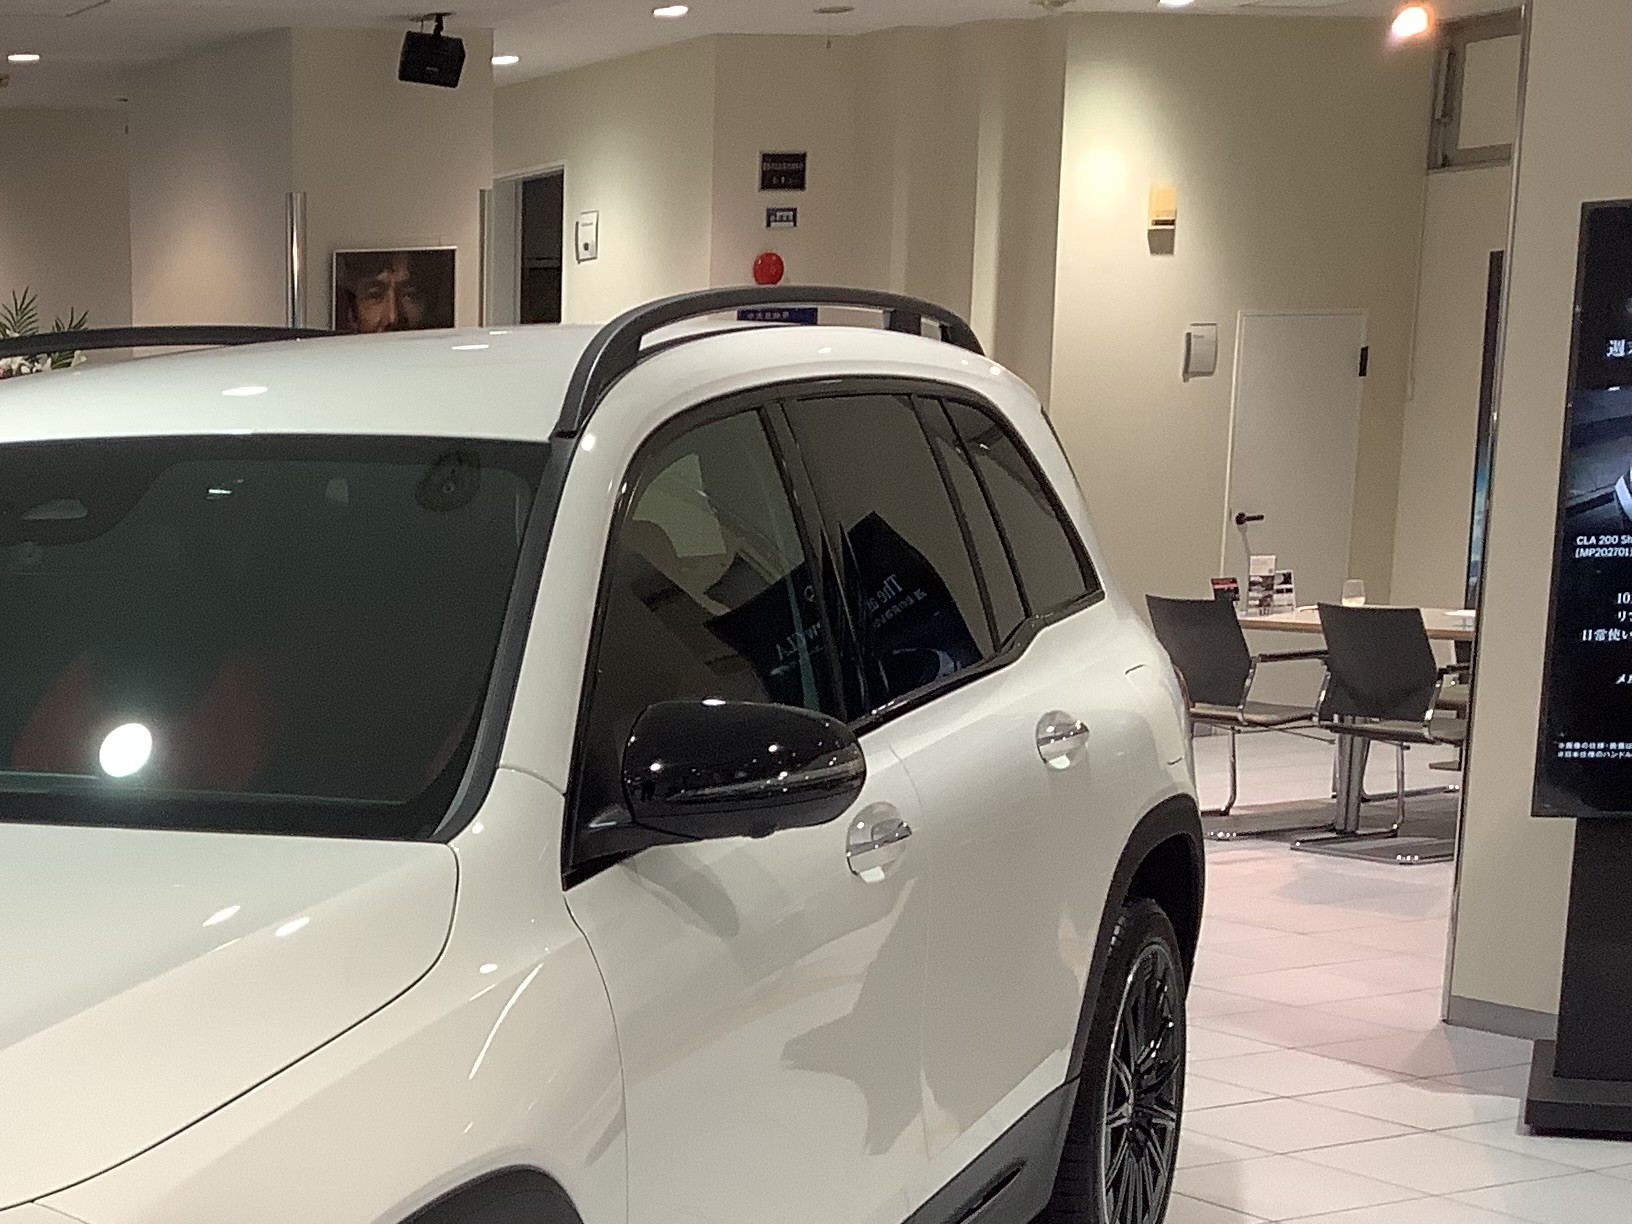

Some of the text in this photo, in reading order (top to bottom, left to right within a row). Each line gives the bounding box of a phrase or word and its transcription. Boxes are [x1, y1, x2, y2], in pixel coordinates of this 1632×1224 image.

[1576, 535, 1597, 546] CLA
[1598, 534, 1619, 545] 200
[1617, 591, 1632, 605] 10
[1582, 628, 1632, 641] 日常使い
